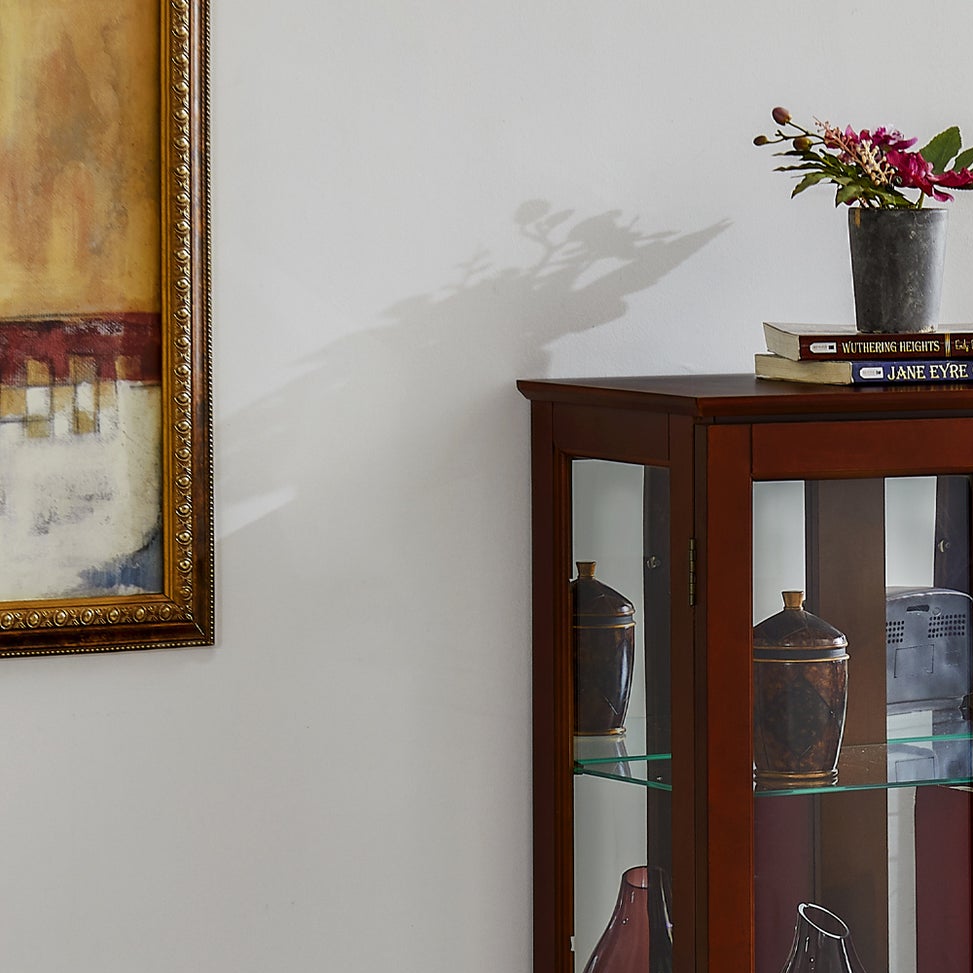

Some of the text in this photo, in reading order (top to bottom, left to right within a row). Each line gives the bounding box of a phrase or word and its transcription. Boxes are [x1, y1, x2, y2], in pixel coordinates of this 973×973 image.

[842, 340, 897, 354] WUTHERING
[900, 340, 941, 352] HEIGHTS
[954, 339, 970, 352] Emily
[887, 364, 926, 380] JANE
[929, 363, 969, 379] EYRE
